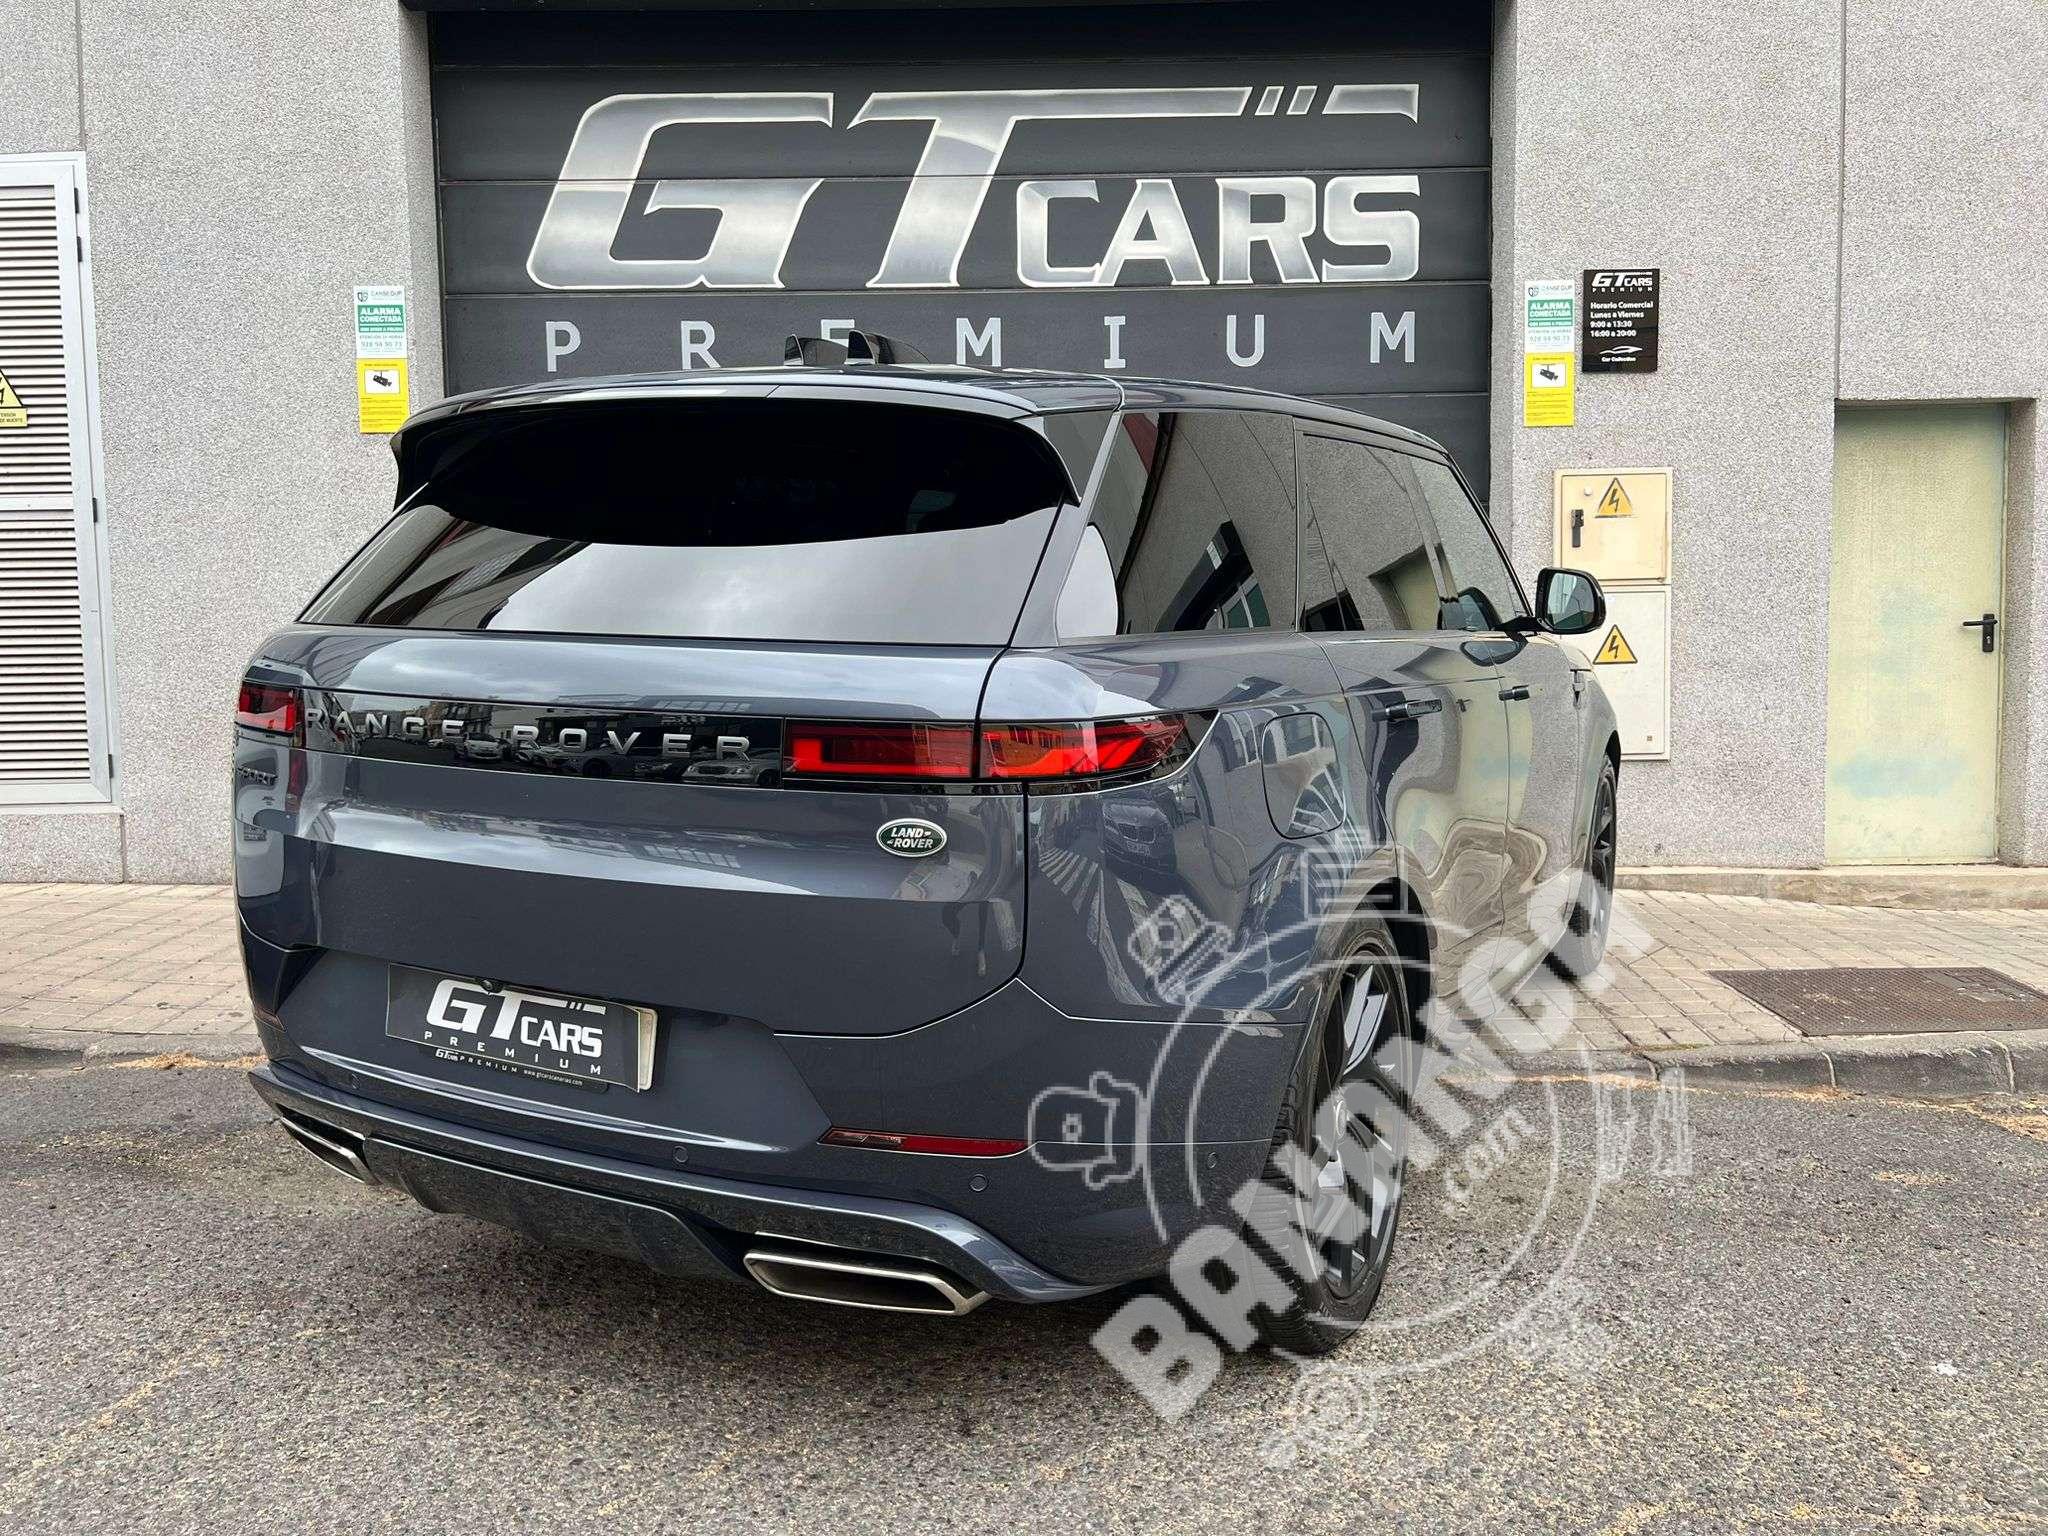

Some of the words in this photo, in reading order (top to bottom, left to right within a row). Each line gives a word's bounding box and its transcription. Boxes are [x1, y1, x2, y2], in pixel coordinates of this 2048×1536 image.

[1530, 301, 1571, 310] ALARMA
[1590, 301, 1617, 309] Horario
[1618, 300, 1654, 309] Comercial
[360, 307, 401, 315] ALARMA
[1590, 311, 1612, 319] Lunes
[1617, 310, 1644, 318] Viernes
[1590, 320, 1606, 328] 9:00
[1590, 330, 1610, 338] 16:00
[1616, 329, 1637, 337] 20:00
[304, 707, 465, 741] RANGE
[511, 724, 752, 762] ROVER
[893, 838, 934, 849] ROVER
[424, 1030, 602, 1076] PREMIUM
